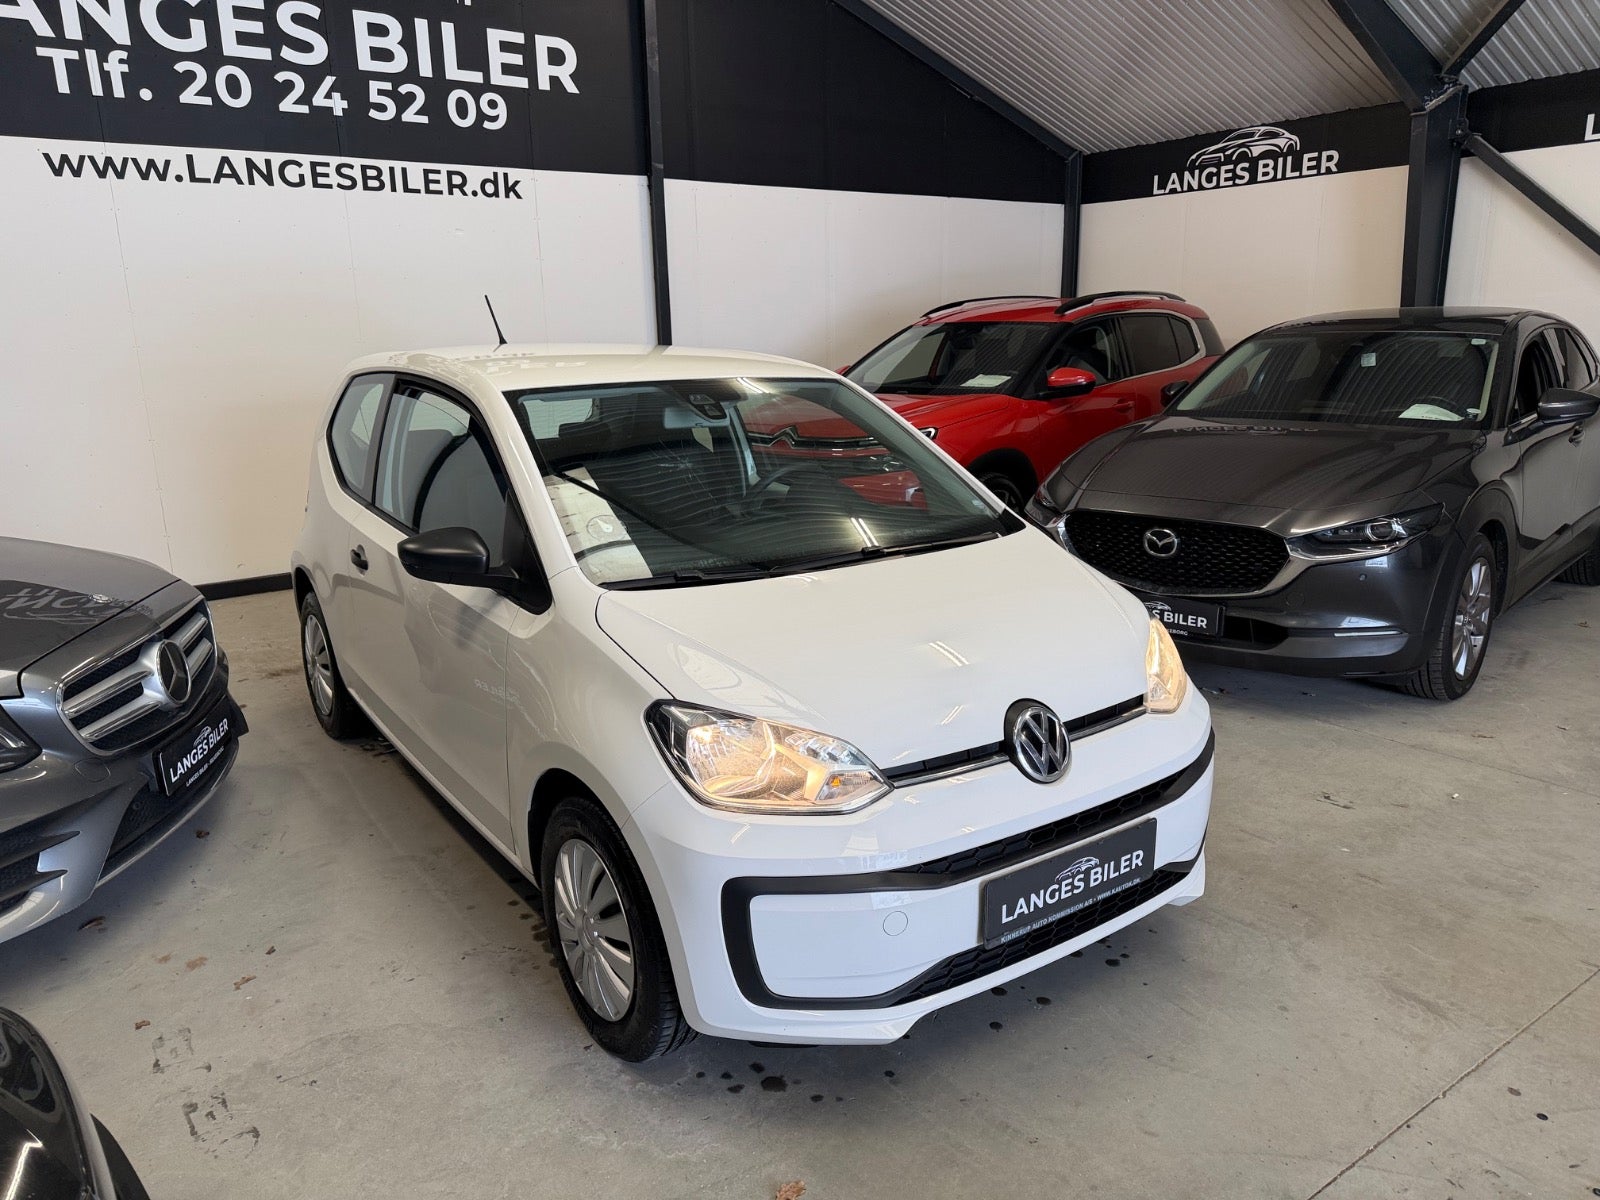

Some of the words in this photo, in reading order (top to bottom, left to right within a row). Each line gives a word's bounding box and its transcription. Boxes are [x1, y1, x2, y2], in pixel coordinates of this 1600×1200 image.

[352, 10, 580, 94] BILER
[36, 46, 153, 101] Tlf.
[174, 61, 252, 109] 20
[274, 71, 349, 117] 24
[368, 80, 429, 124] 52
[447, 89, 508, 130] 09
[42, 152, 523, 200] www.LANGESBILER.dk
[1153, 162, 1250, 195] LANGES
[1257, 150, 1340, 182] BILER
[1163, 611, 1208, 629] BILER
[170, 740, 209, 783] LANGES
[209, 718, 229, 749] BILER
[1001, 873, 1085, 924] LANGES
[1089, 849, 1144, 888] BILER
